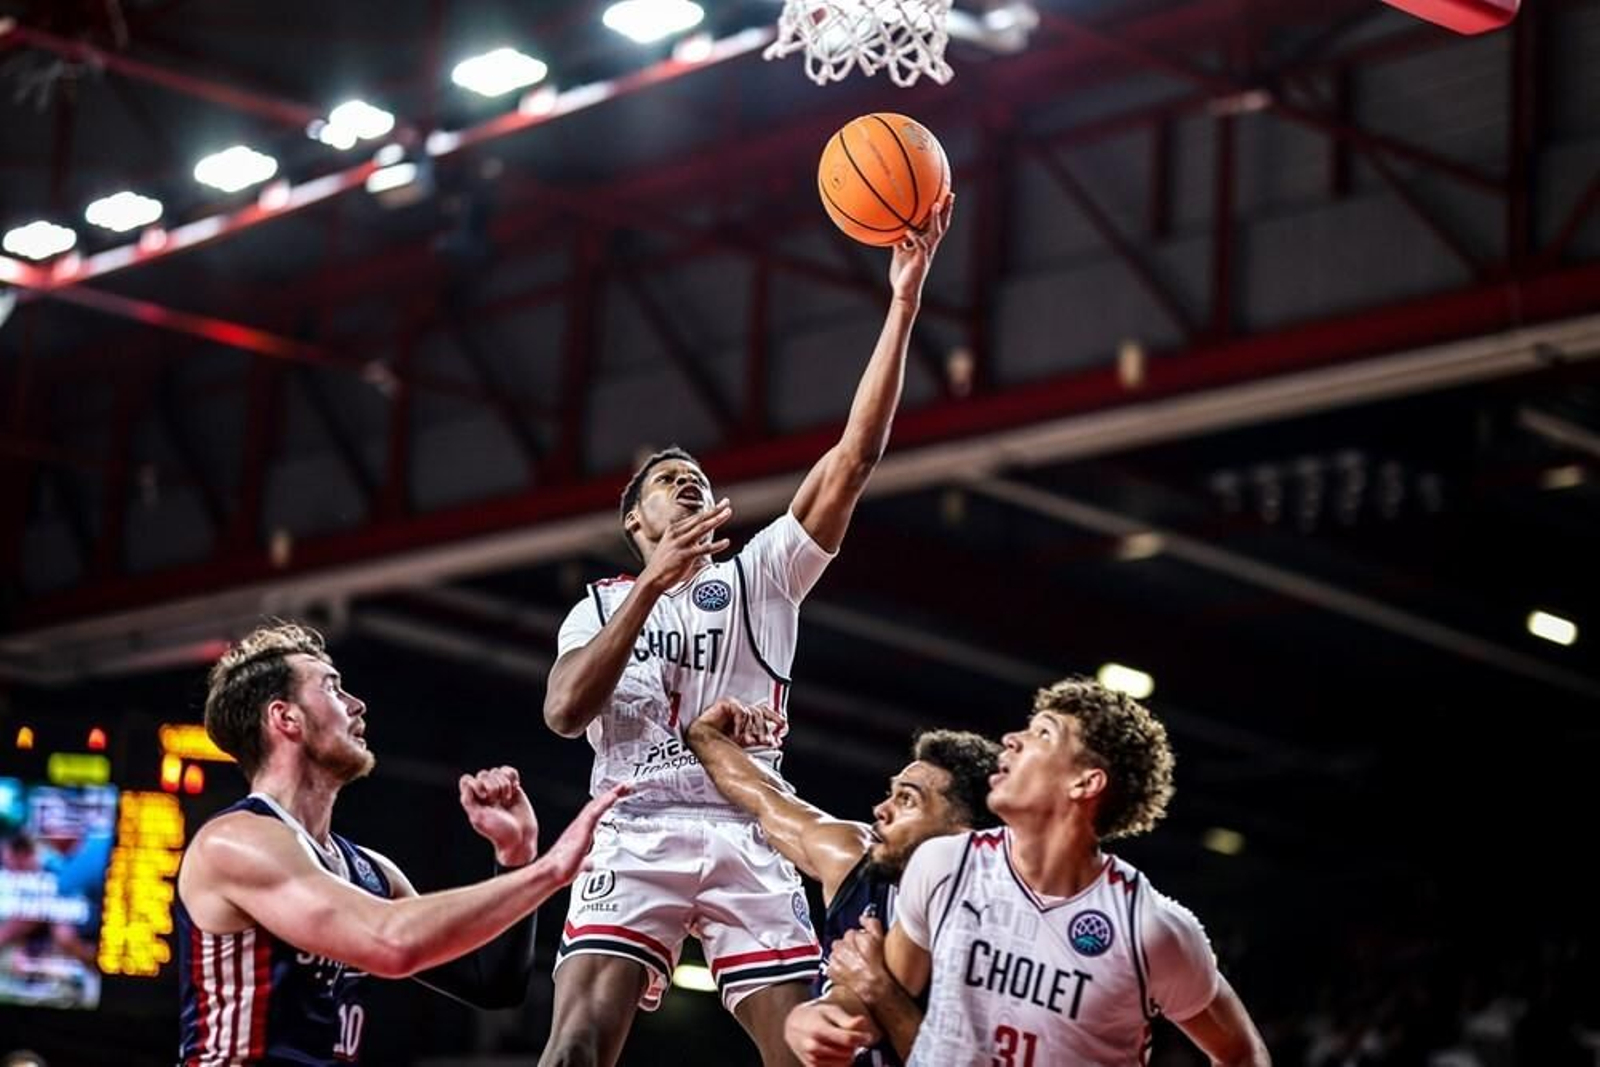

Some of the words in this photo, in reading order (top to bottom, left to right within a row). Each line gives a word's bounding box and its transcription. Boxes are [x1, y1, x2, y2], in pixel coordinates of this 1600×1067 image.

[633, 755, 701, 778] Transpo
[964, 939, 1093, 1020] CHOLET
[333, 1003, 364, 1056] 10
[991, 1024, 1038, 1067] 31
